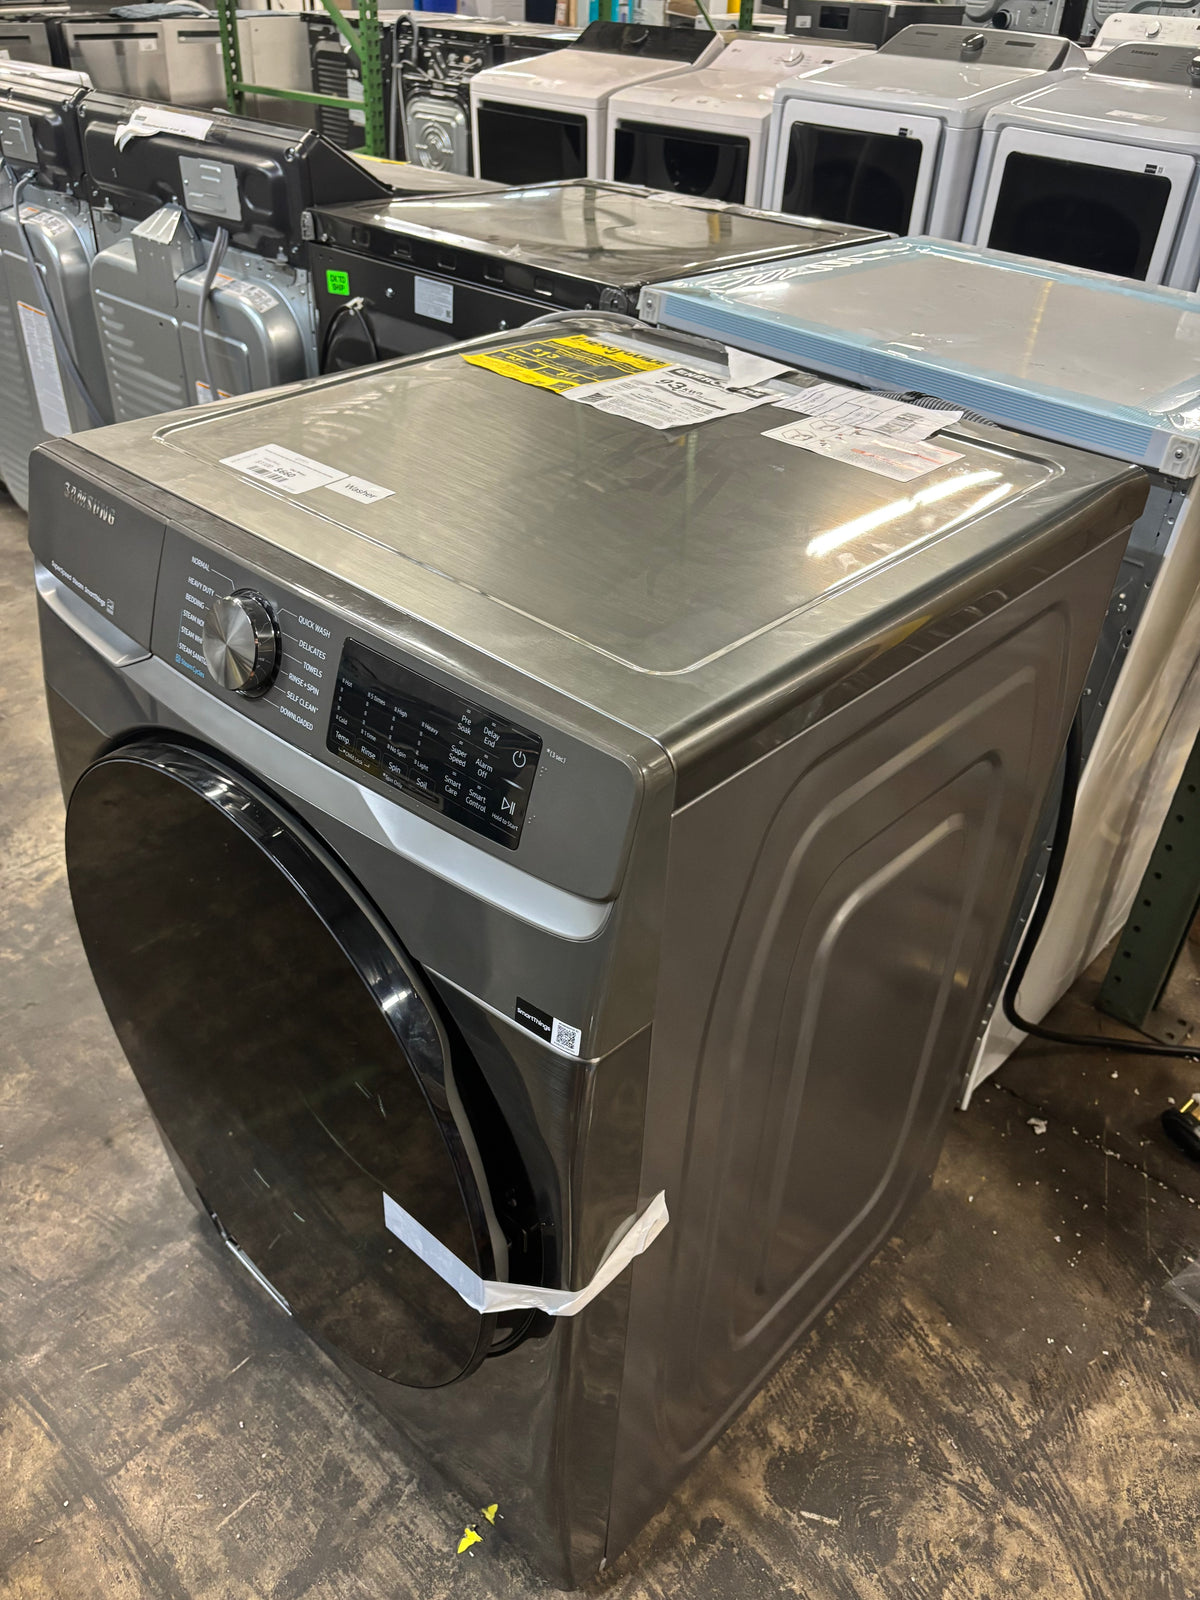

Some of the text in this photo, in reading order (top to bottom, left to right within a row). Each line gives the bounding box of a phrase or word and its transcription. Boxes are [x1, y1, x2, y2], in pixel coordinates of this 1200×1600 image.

[345, 483, 377, 499] Washer
[64, 481, 116, 526] SAMSUNG
[191, 556, 210, 572] NORMAL
[187, 576, 215, 597] HEAVY DUTY
[185, 593, 205, 609] BEDDING
[182, 609, 197, 623] STEAM
[180, 626, 195, 640] STEAM
[298, 615, 331, 639] QUICK WASH
[178, 643, 193, 657] STEAM
[298, 639, 327, 661] DELICATES
[303, 661, 323, 679] TOWELS
[286, 690, 300, 703] SELF
[279, 705, 314, 732] DOWNLOADED
[338, 715, 348, 726] Cold
[397, 708, 408, 719] High
[461, 714, 472, 726] Pre
[424, 722, 439, 736] Heavy
[457, 722, 472, 736] Soak
[483, 726, 501, 742] Delay
[483, 737, 496, 749] End
[360, 745, 377, 760] Rinse
[450, 744, 468, 759] Super
[416, 760, 429, 772] Light
[448, 752, 467, 768] Speed
[475, 758, 494, 773] Alarm
[388, 761, 402, 775] Spin
[477, 768, 488, 779] Off
[416, 777, 428, 790] Soil
[444, 775, 462, 790] Smart
[444, 784, 458, 797] Care
[468, 788, 487, 804] Smart
[465, 796, 487, 814] Control
[491, 812, 502, 823] Hold
[506, 819, 519, 832] Start
